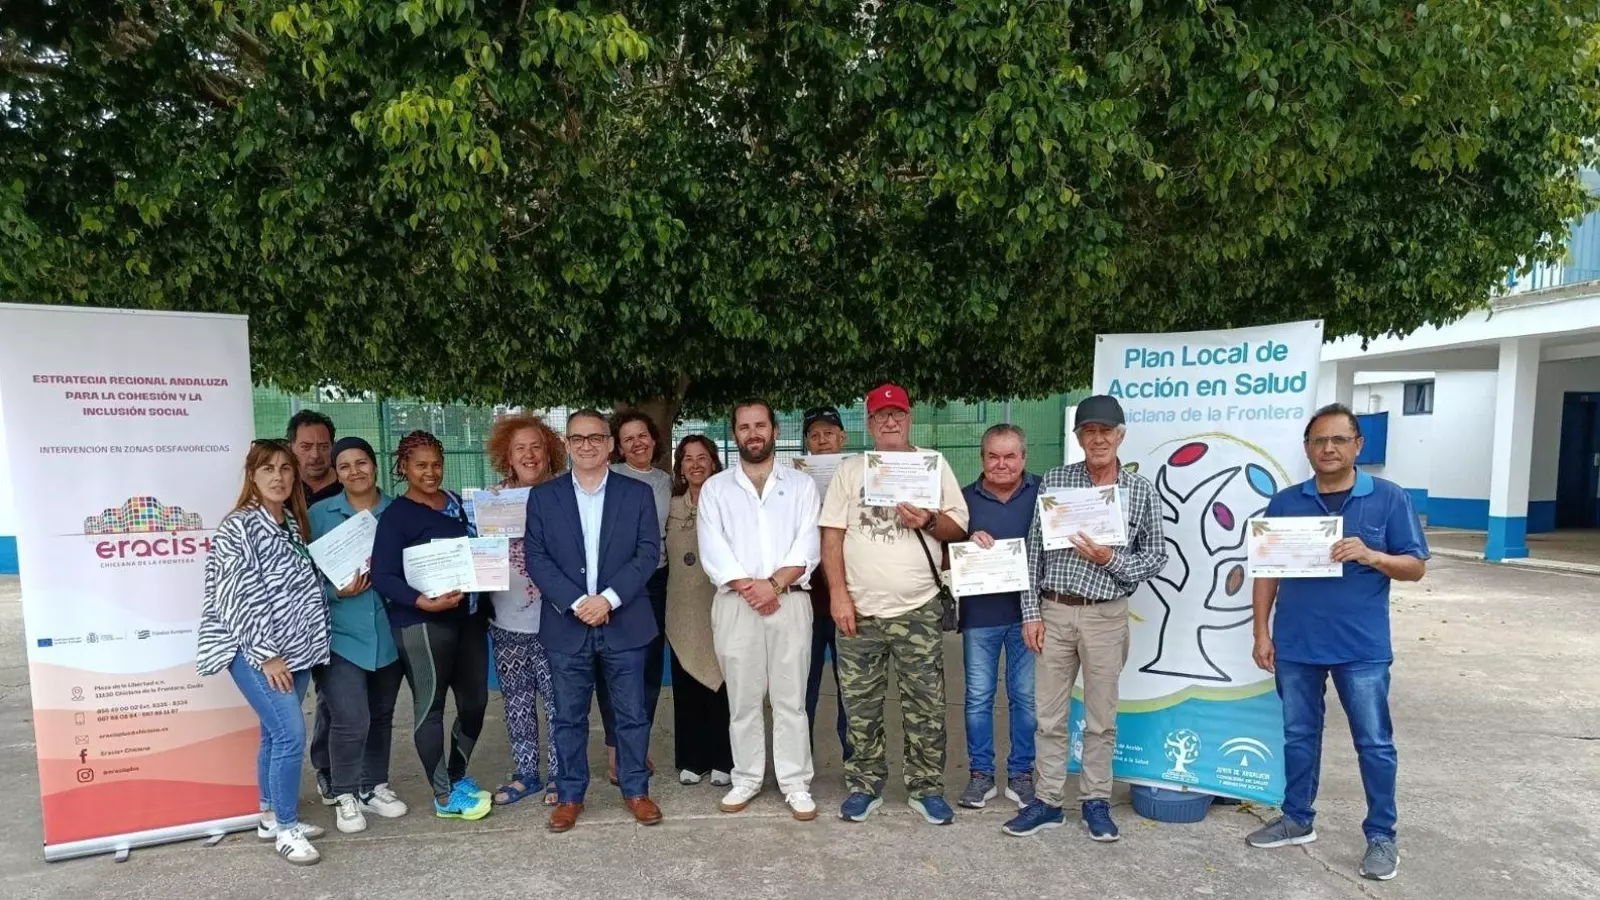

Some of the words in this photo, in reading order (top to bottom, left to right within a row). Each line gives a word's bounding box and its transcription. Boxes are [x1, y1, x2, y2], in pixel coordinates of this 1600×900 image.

[1124, 347, 1175, 369] Plan
[1181, 342, 1248, 367] Local
[1256, 340, 1288, 362] de
[32, 374, 107, 385] ESTRATEGIA
[109, 375, 168, 386] REGIONAL
[169, 377, 229, 387] ANDALUZA
[1108, 376, 1189, 399] Acción
[1196, 379, 1227, 396] en
[1234, 371, 1307, 396] Salud
[65, 390, 100, 401] PARA
[101, 391, 116, 401] LA
[117, 389, 178, 401] COHESIÓN
[178, 391, 187, 401] Y
[189, 392, 203, 402] LA
[82, 405, 146, 417] INCLUSIÓN
[148, 407, 189, 417] SOCIAL
[1125, 408, 1176, 423] iclana
[1180, 407, 1203, 422] de
[1207, 406, 1222, 422] la
[1226, 404, 1304, 422] Frontera
[39, 445, 108, 454] INTERVENCIÓN
[109, 445, 123, 454] EN
[124, 445, 154, 454] ZONAS
[155, 444, 230, 453] DESFAVORECIDAS
[100, 560, 136, 569] CHICLANA
[158, 558, 195, 566] FRONTERA
